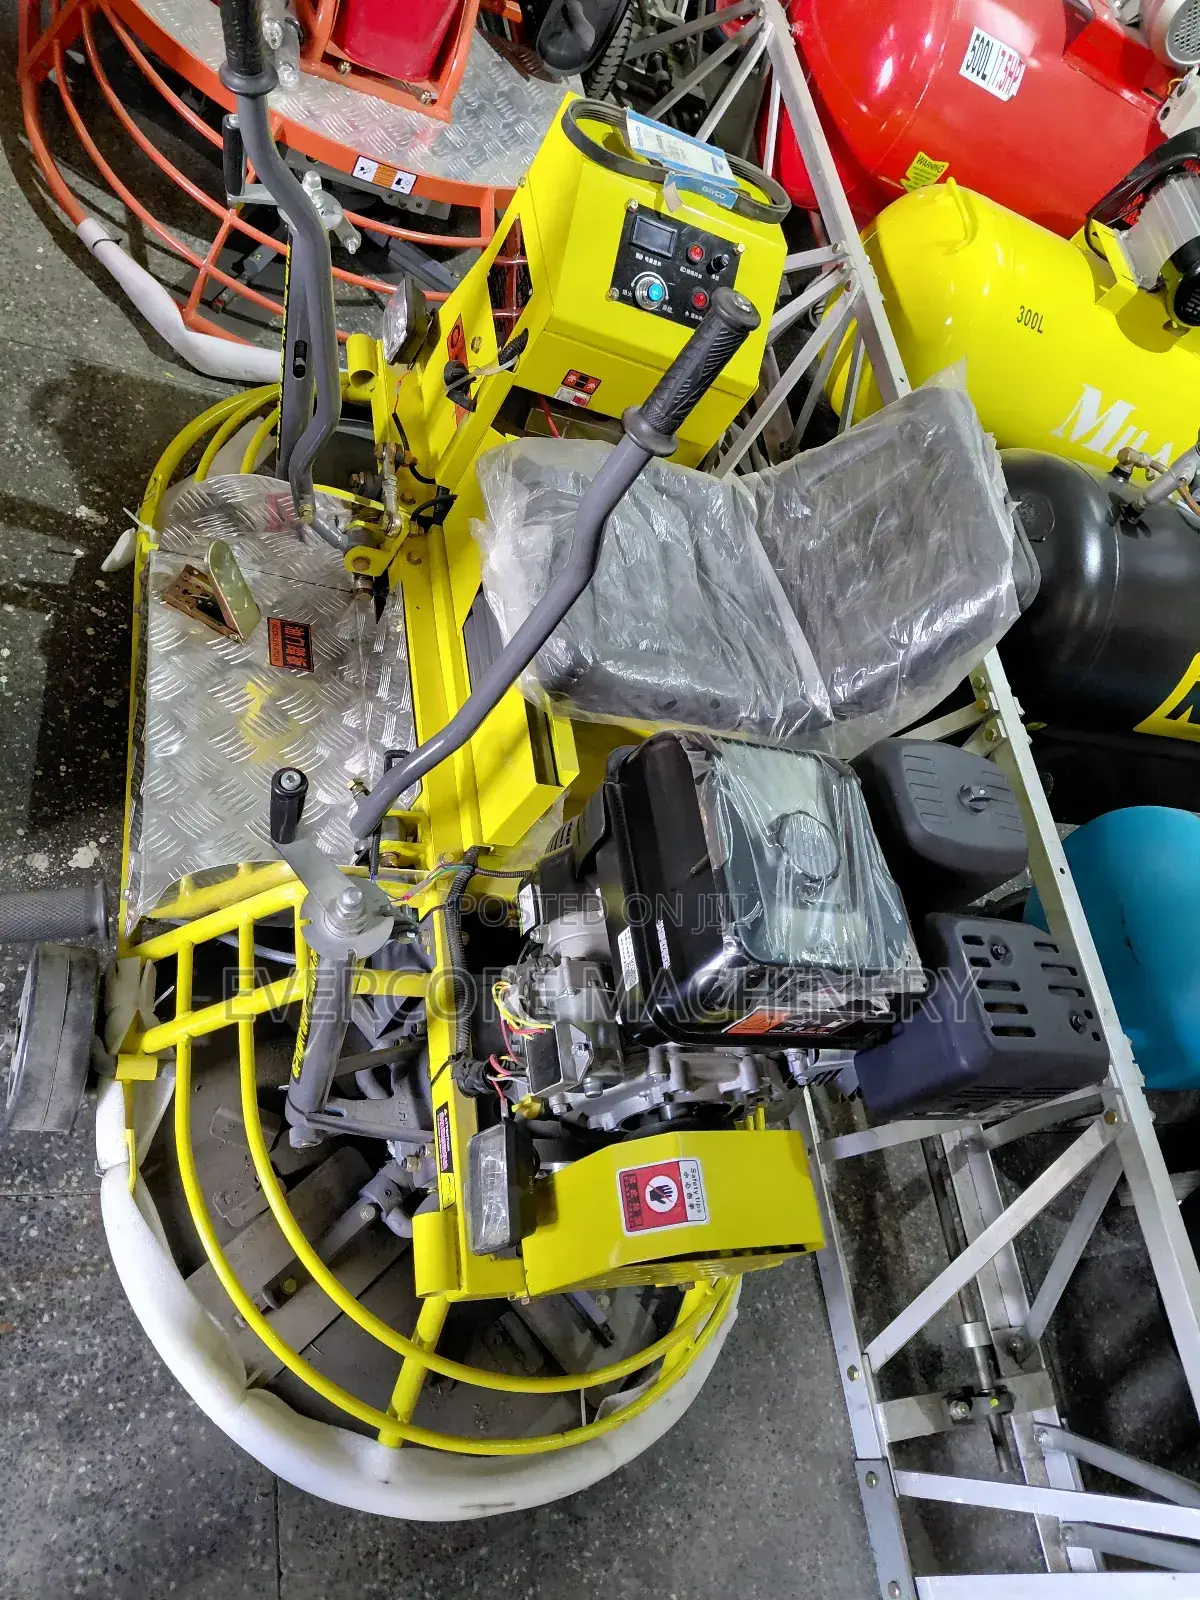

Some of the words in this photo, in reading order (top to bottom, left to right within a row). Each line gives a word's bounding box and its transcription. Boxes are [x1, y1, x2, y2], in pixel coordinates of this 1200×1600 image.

[964, 34, 995, 82] 500L
[915, 154, 944, 175] WARNING
[701, 186, 728, 200] DAYCO
[1016, 305, 1044, 334] 300L
[690, 1168, 698, 1195] Safety
